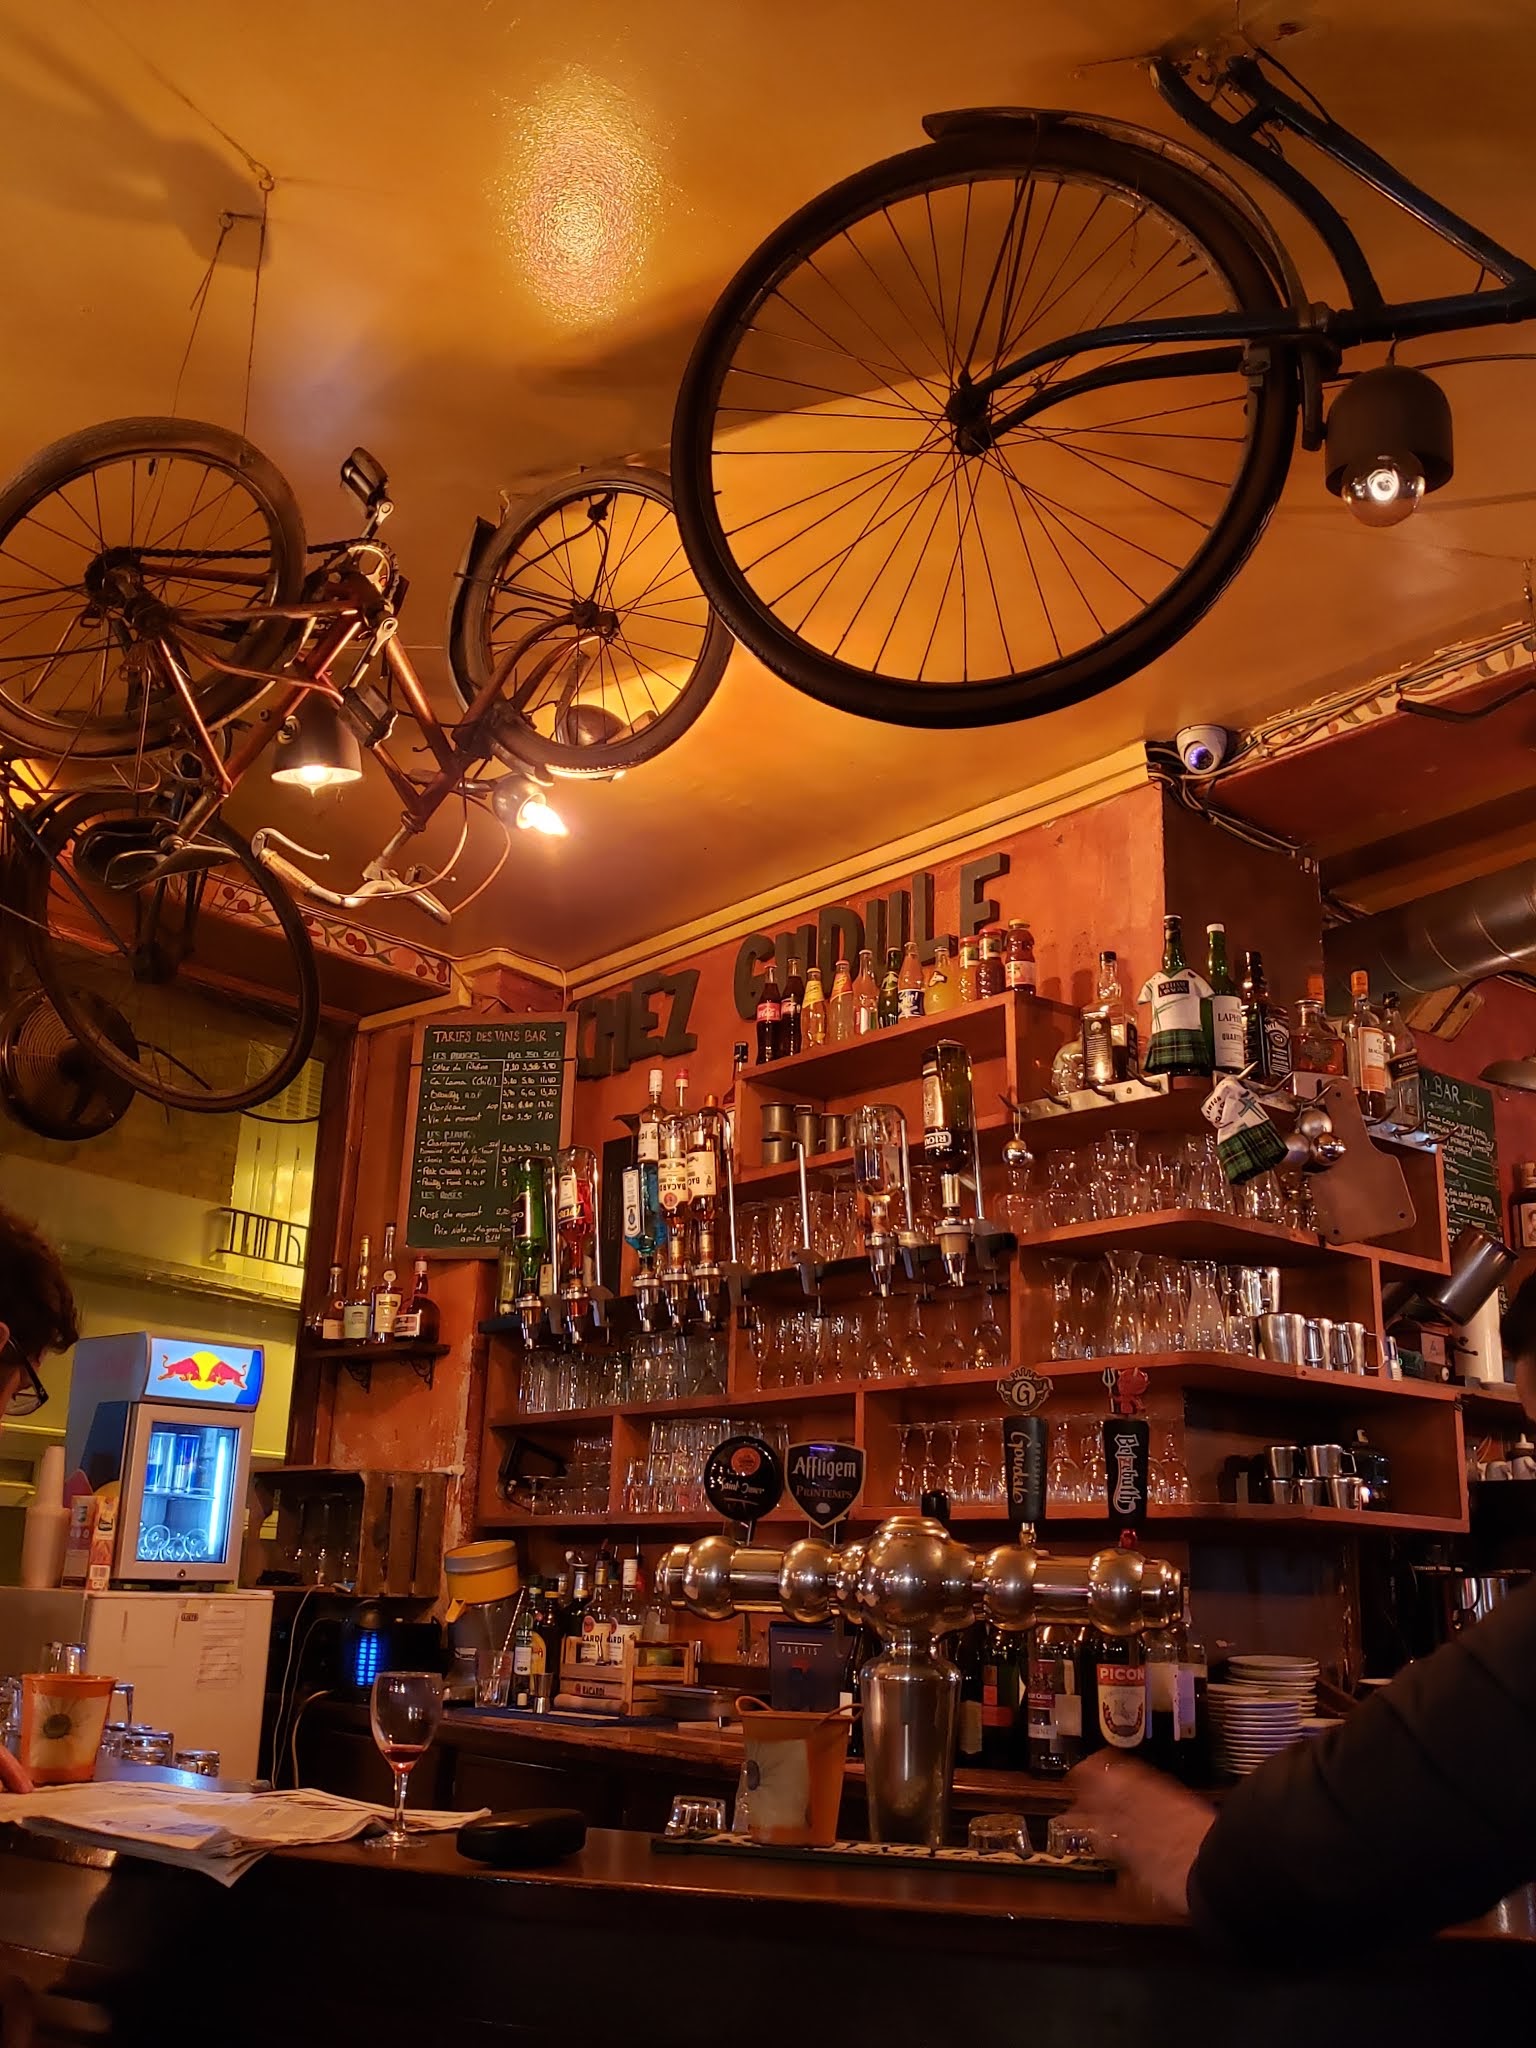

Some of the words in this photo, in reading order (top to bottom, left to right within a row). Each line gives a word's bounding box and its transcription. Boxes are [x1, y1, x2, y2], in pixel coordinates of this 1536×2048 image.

[577, 968, 702, 1081] CHEZ
[433, 1031, 472, 1043] TARIFS
[476, 1031, 493, 1042] DES
[495, 1030, 520, 1042] VINS
[524, 1029, 547, 1042] BAR
[1430, 1075, 1461, 1105] BAR
[792, 1455, 857, 1482] Affligem
[796, 1484, 853, 1500] PRINTEMPS
[781, 1646, 819, 1656] PASTIS
[1100, 1667, 1145, 1681] PICON
